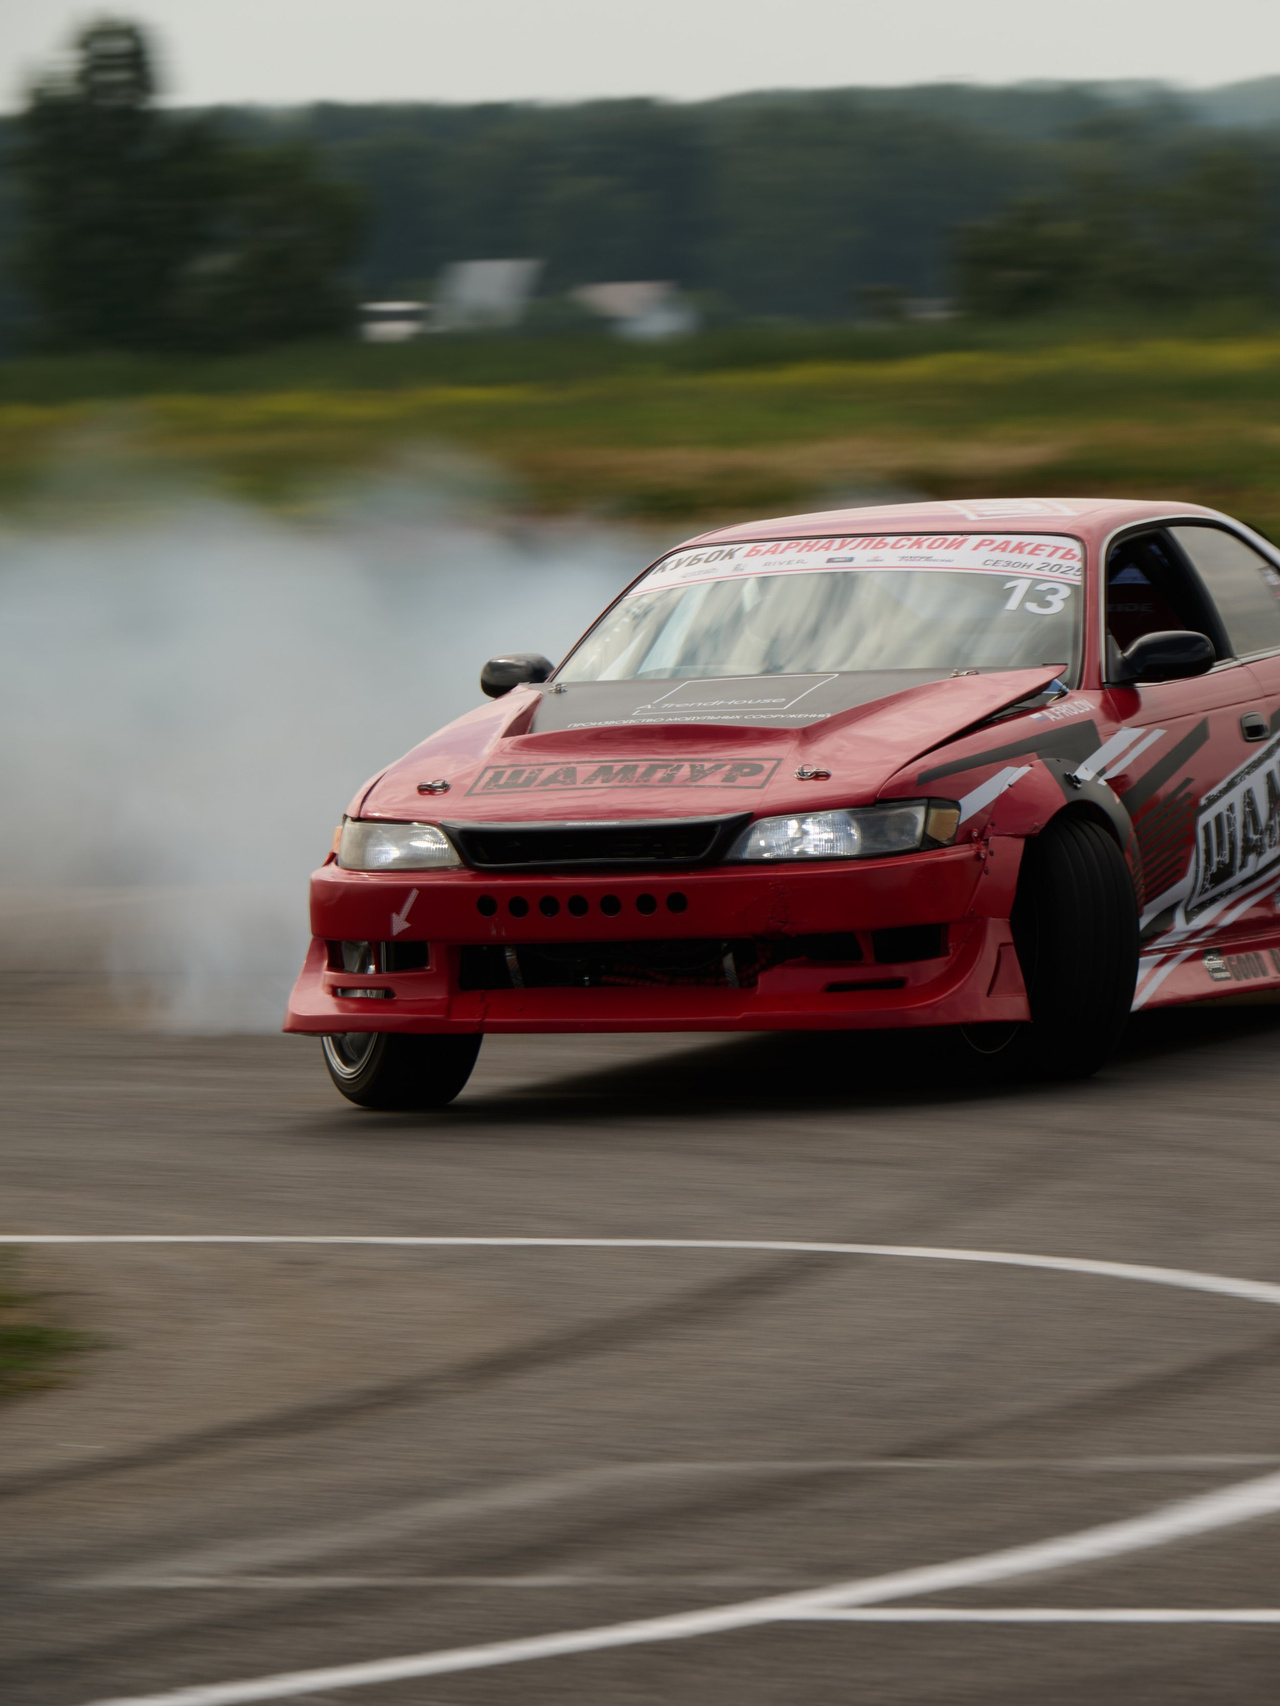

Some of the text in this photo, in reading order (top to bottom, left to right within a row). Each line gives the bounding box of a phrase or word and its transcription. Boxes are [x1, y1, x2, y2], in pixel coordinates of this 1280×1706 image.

[653, 547, 744, 575] КУБОК
[743, 535, 971, 558] БАРНАУЛЬСКОЙ
[982, 559, 1083, 577] СЕЗОН 2025
[1003, 578, 1072, 615] 13
[567, 712, 832, 729] ПРОИЗВОДСТВО МОДУЛЬНЫХ СООРУЖЕНИЙ
[481, 763, 766, 790] ШАМПУР
[1226, 950, 1270, 982] GOOD
